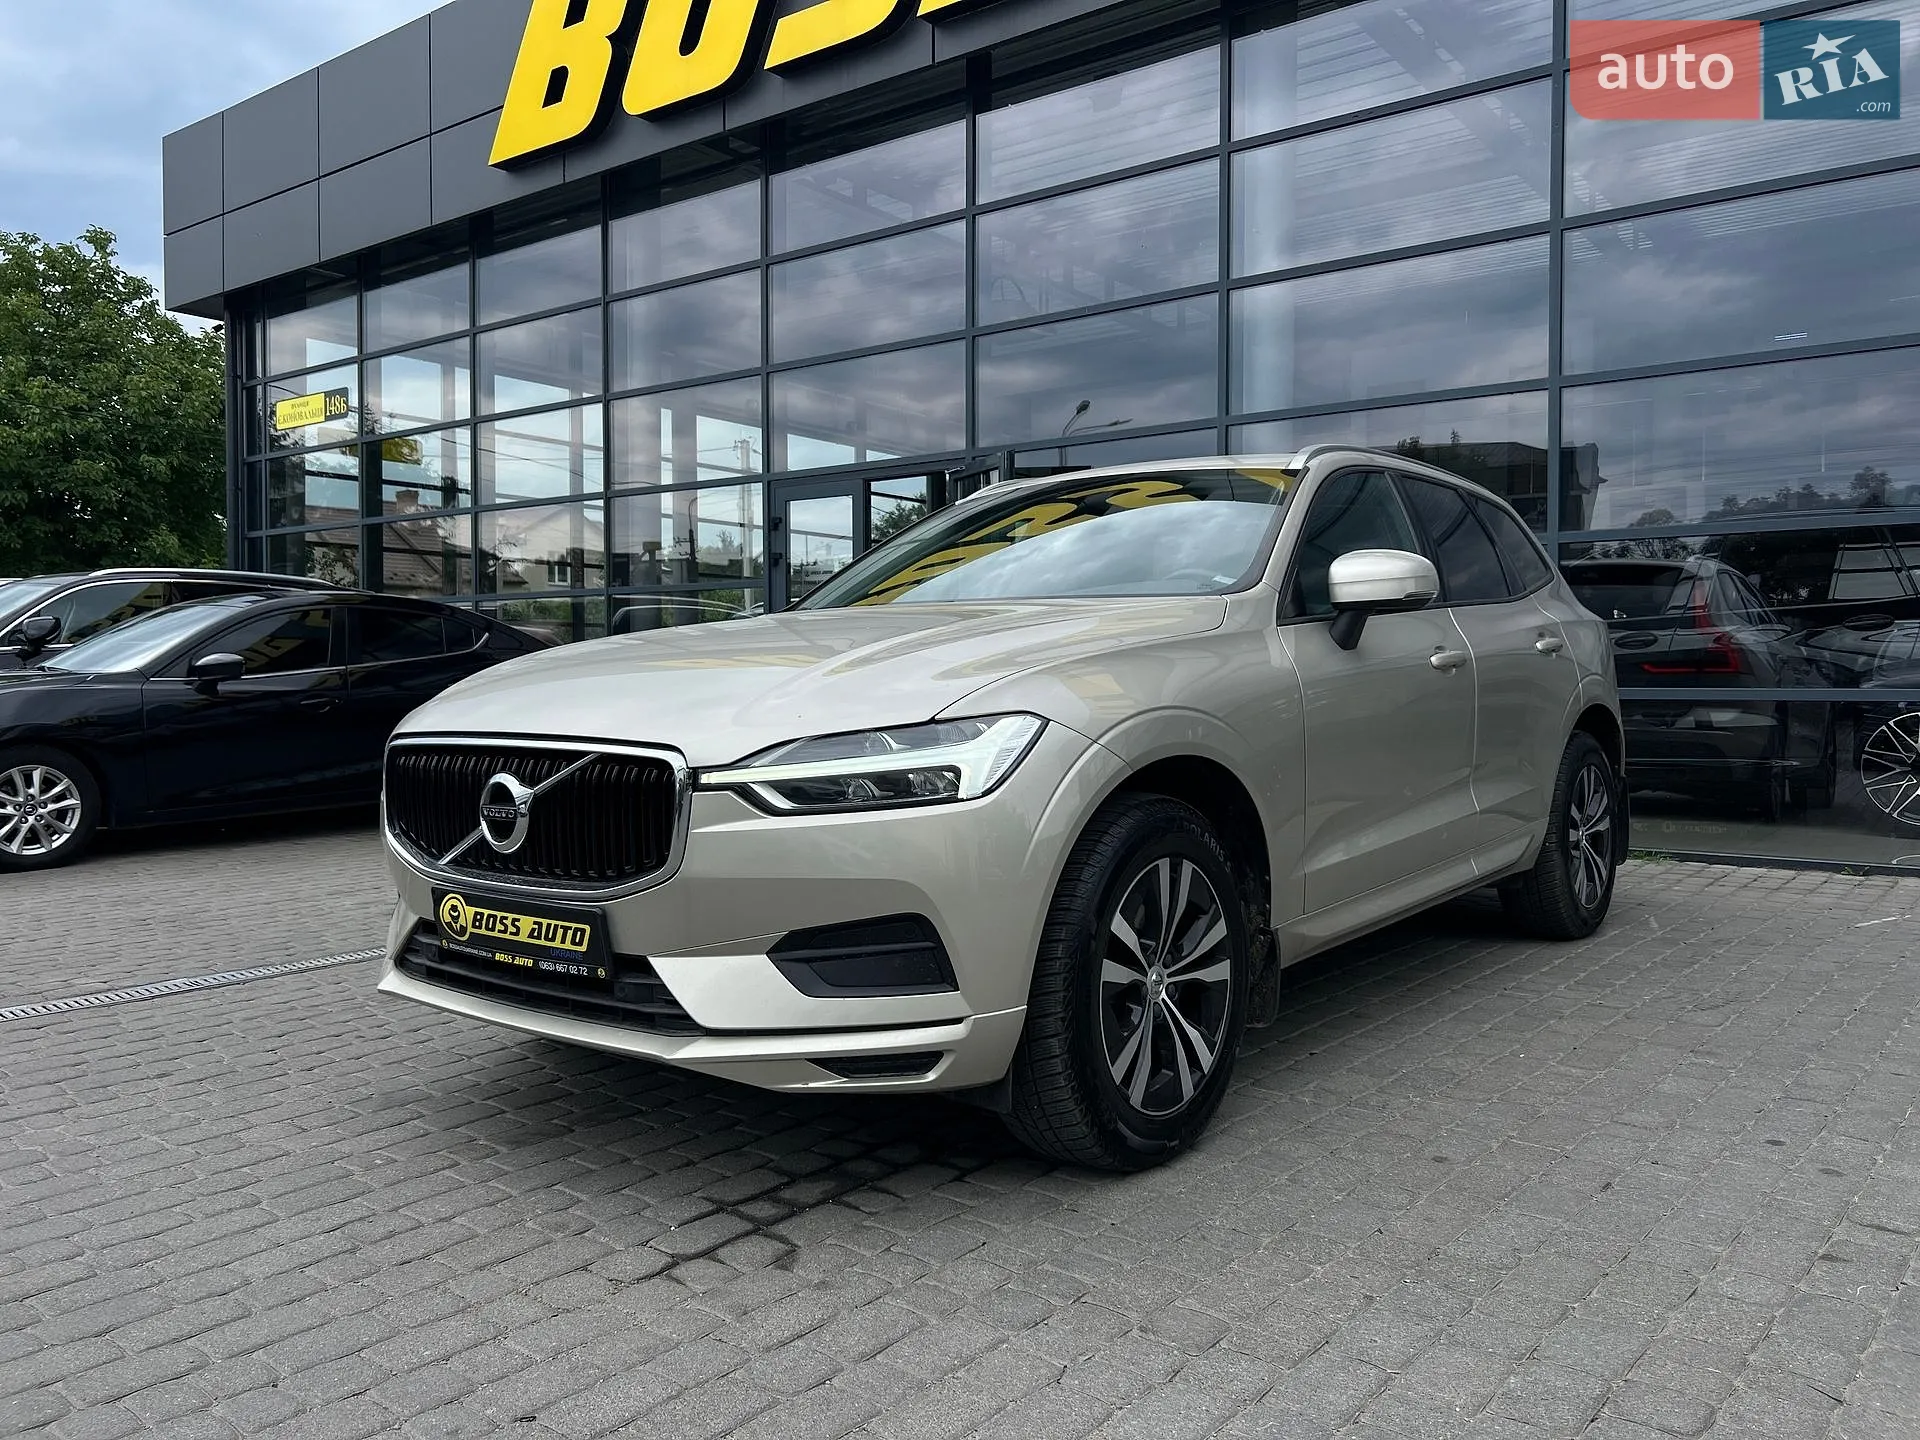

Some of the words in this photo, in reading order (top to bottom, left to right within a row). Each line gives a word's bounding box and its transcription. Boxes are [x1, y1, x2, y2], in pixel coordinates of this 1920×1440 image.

[325, 394, 347, 416] 148Б
[482, 807, 515, 818] VOLVO
[1184, 821, 1225, 862] POLARIS
[471, 911, 521, 937] BOSS
[527, 920, 587, 947] AUTO
[494, 953, 512, 963] BOSS
[513, 956, 533, 967] AUTO
[550, 947, 583, 961] UKRAINE
[539, 961, 555, 971] (063)
[556, 964, 568, 973] 667
[569, 965, 578, 974] 02
[579, 967, 588, 976] 72
